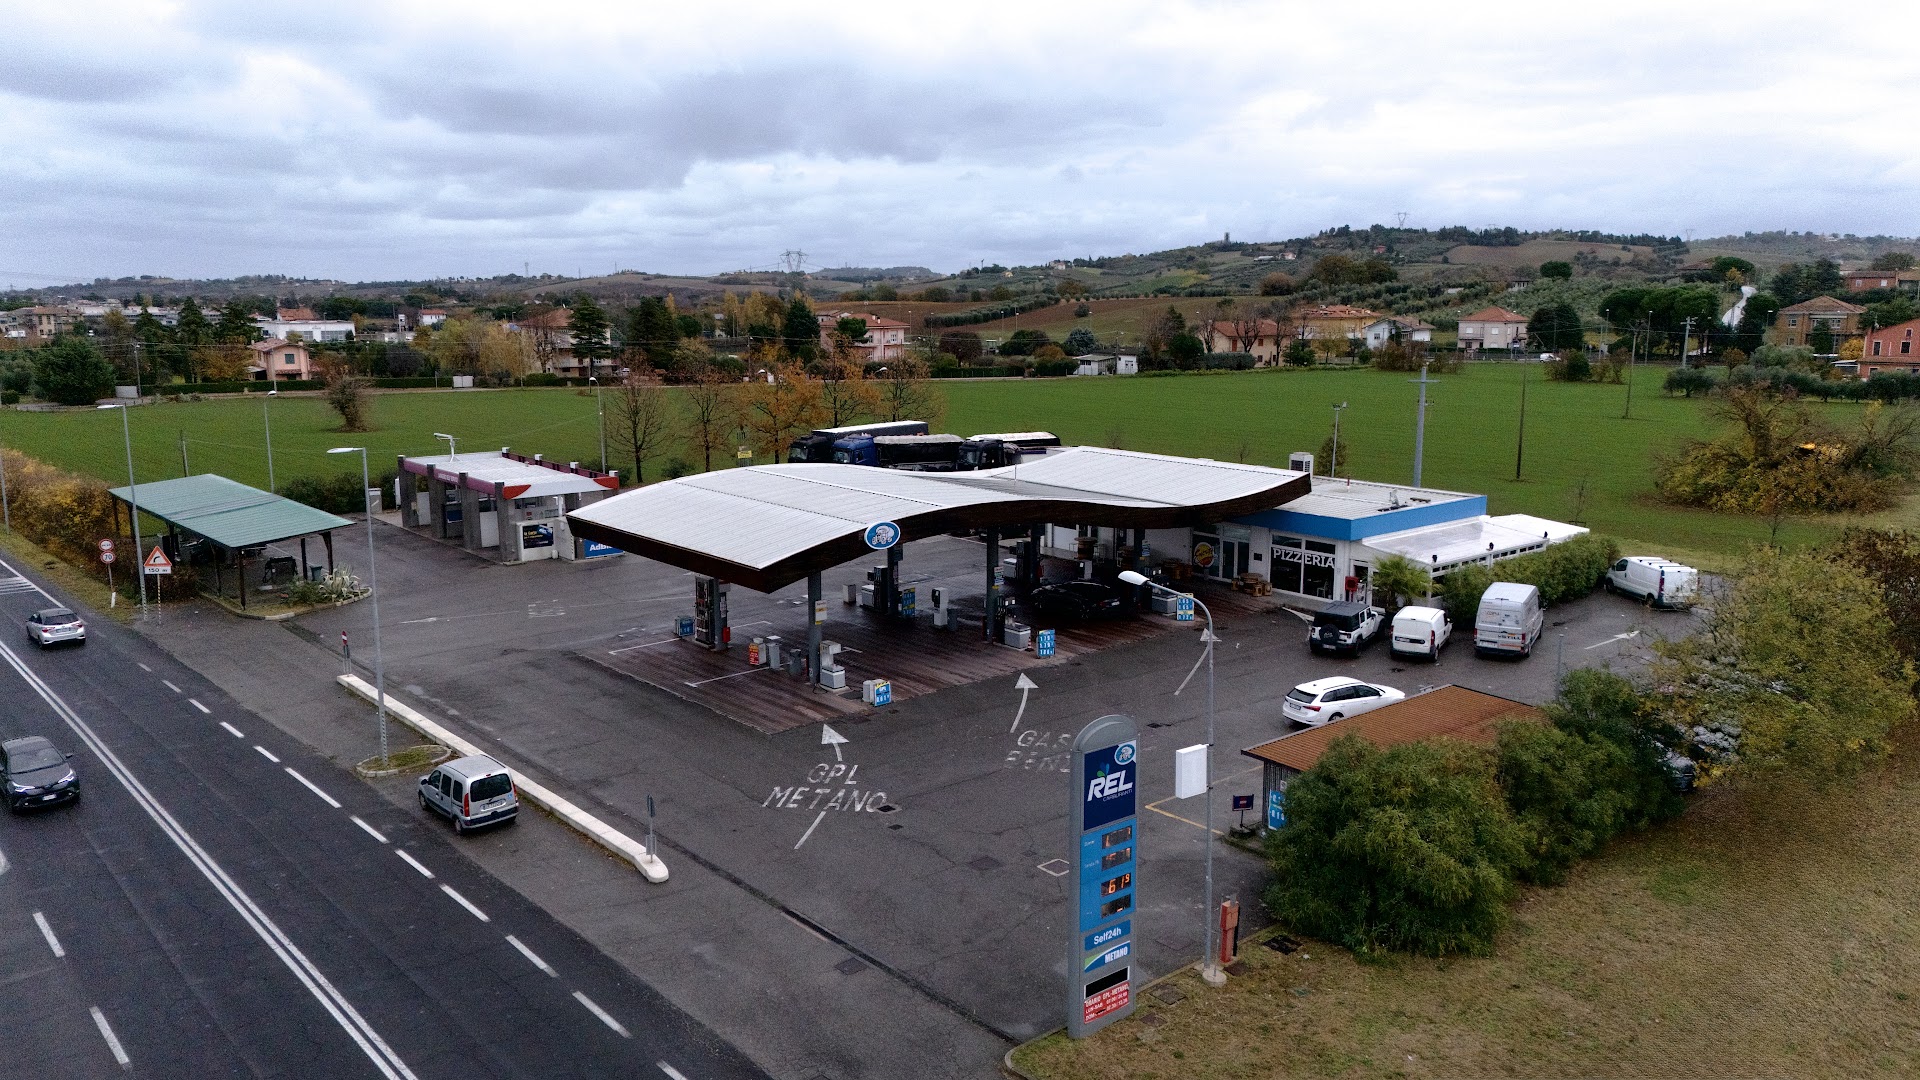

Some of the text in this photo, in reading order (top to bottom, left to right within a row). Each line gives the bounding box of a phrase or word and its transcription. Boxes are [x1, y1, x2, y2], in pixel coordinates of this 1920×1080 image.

[1273, 548, 1335, 568] PIZZERIA
[806, 763, 859, 785] GPL
[1087, 769, 1133, 802] REL
[761, 786, 888, 813] METANO
[1094, 927, 1122, 945] Self24h
[1105, 946, 1128, 963] METANO
